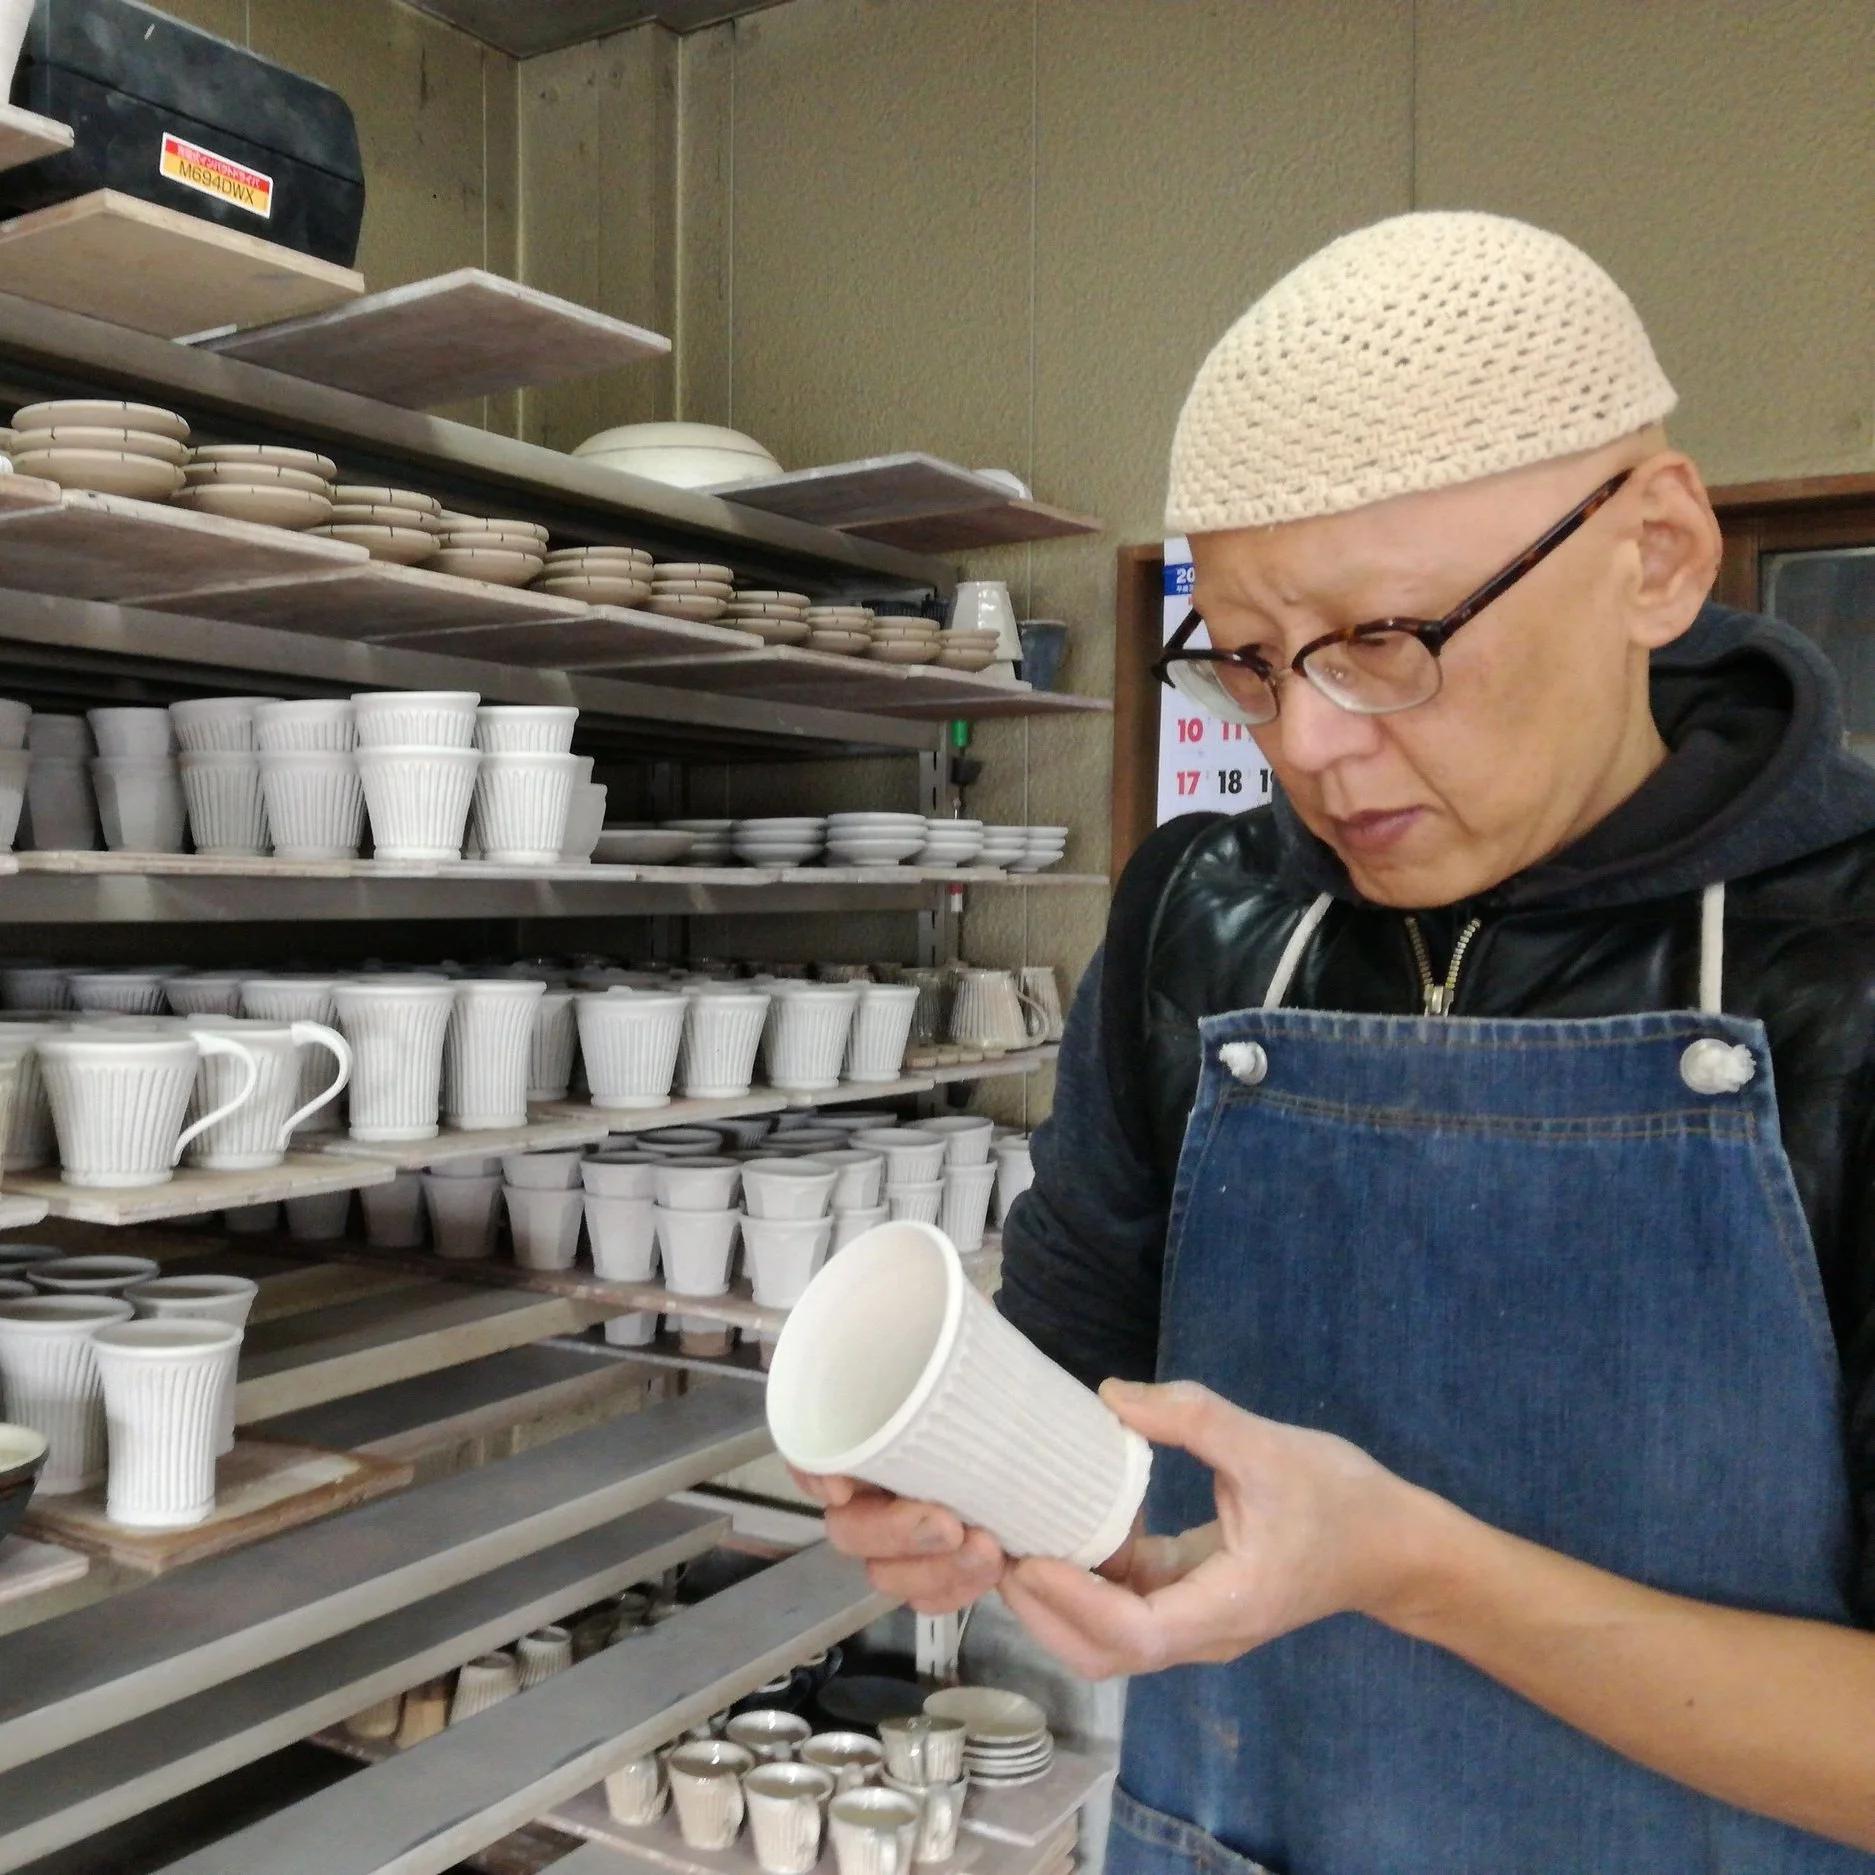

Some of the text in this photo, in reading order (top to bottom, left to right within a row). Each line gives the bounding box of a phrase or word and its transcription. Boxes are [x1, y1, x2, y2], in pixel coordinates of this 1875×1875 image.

[179, 160, 255, 206] M694DWX
[1177, 718, 1204, 743] 10
[1176, 768, 1274, 795] 17 18 1
